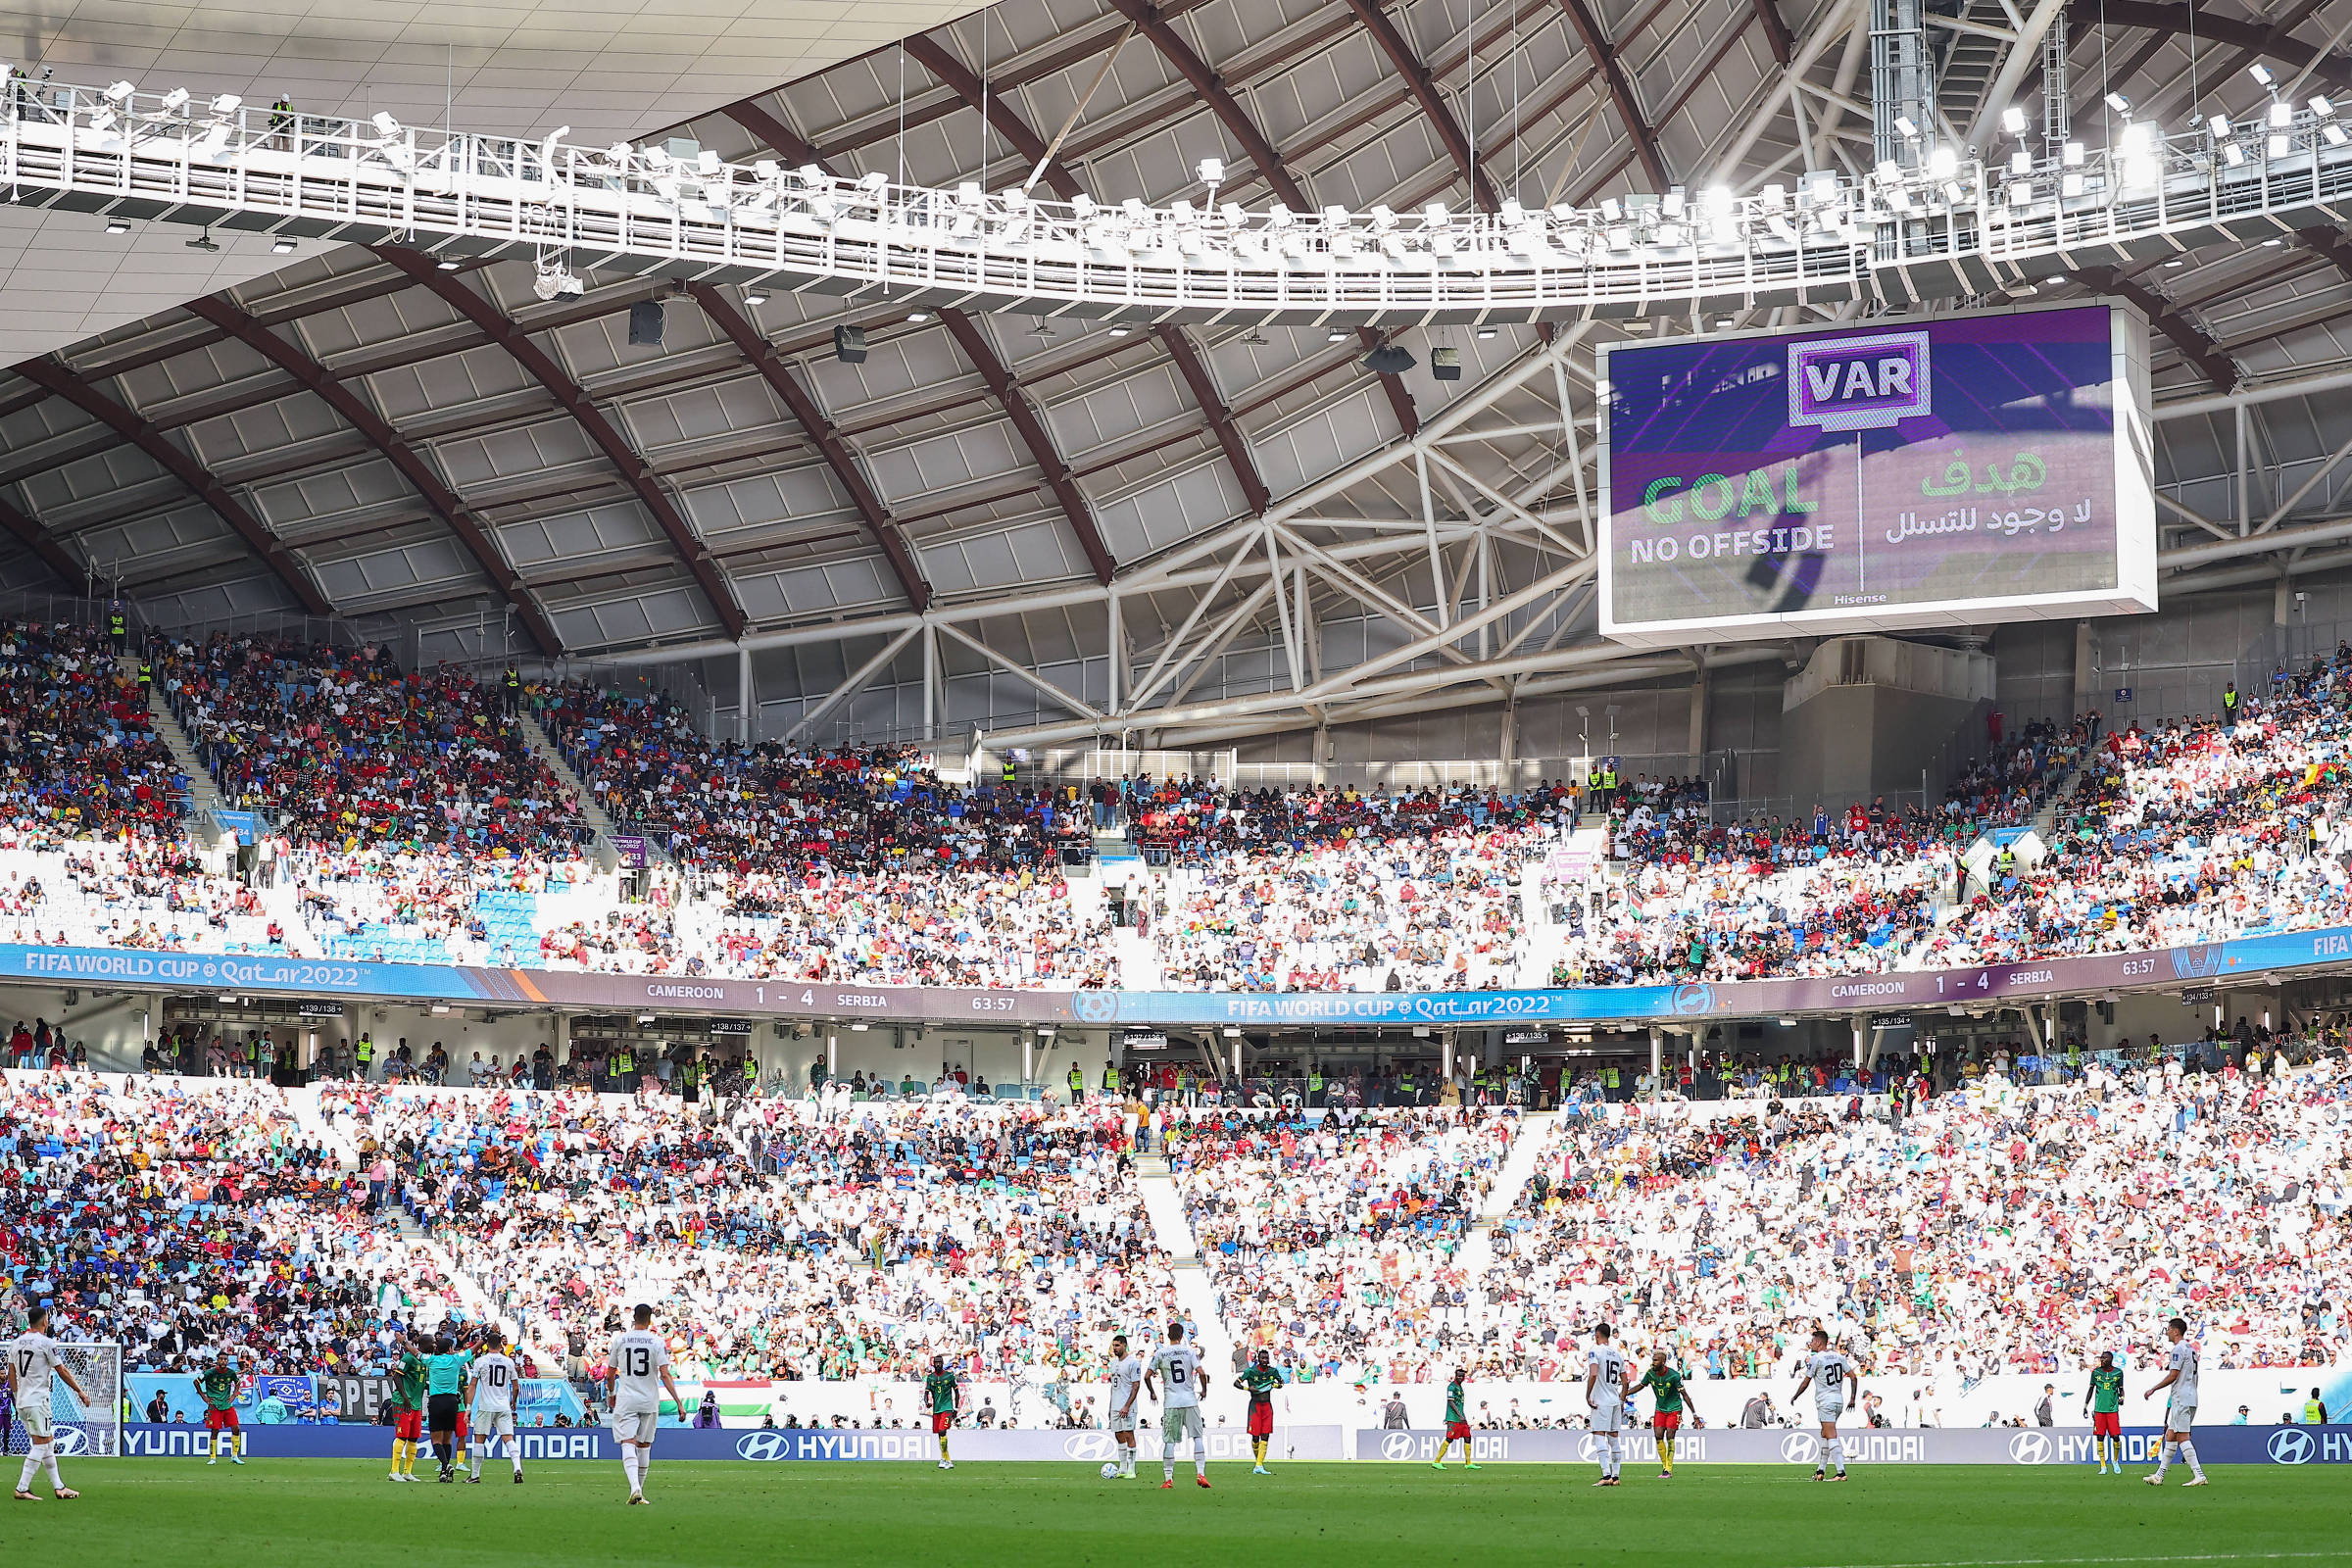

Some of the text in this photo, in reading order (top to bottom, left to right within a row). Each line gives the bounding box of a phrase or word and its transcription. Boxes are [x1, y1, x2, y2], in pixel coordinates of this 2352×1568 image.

[1805, 357, 1913, 402] VAR
[1922, 448, 2046, 496] هدف
[1644, 467, 1819, 524] GOAL
[1886, 498, 2091, 544] لا وجود للتسلل
[1631, 524, 1835, 564] NO OFFSIDE
[1834, 594, 1886, 605] Hisense
[2313, 936, 2346, 956] FIFA
[25, 953, 73, 971] FIFA
[75, 956, 153, 975] WORLD
[157, 959, 199, 978] CUP
[2123, 958, 2155, 975] 63:57
[1831, 981, 1905, 998] CAMEROON
[1936, 976, 1944, 994] 1
[1978, 972, 1989, 990] 4
[2009, 969, 2054, 985] SERBIA
[647, 984, 724, 1000] CAMEROON
[757, 987, 764, 1004] 1
[800, 989, 814, 1005] 4
[837, 994, 888, 1007] SERBIA
[971, 997, 1015, 1010] 63:57
[1227, 1001, 1273, 1016] FIFA
[1274, 1000, 1350, 1016] WORLD
[1353, 1000, 1395, 1016] CUP
[1057, 1323, 1071, 1335] 22
[19, 1349, 34, 1377] 17
[626, 1348, 650, 1376] 13
[1169, 1360, 1186, 1384] 6
[1606, 1360, 1620, 1384] 16
[489, 1365, 507, 1387] 10
[1113, 1378, 1118, 1388] 9
[1825, 1363, 1843, 1386] 20
[798, 1435, 931, 1459] HYUNDAI
